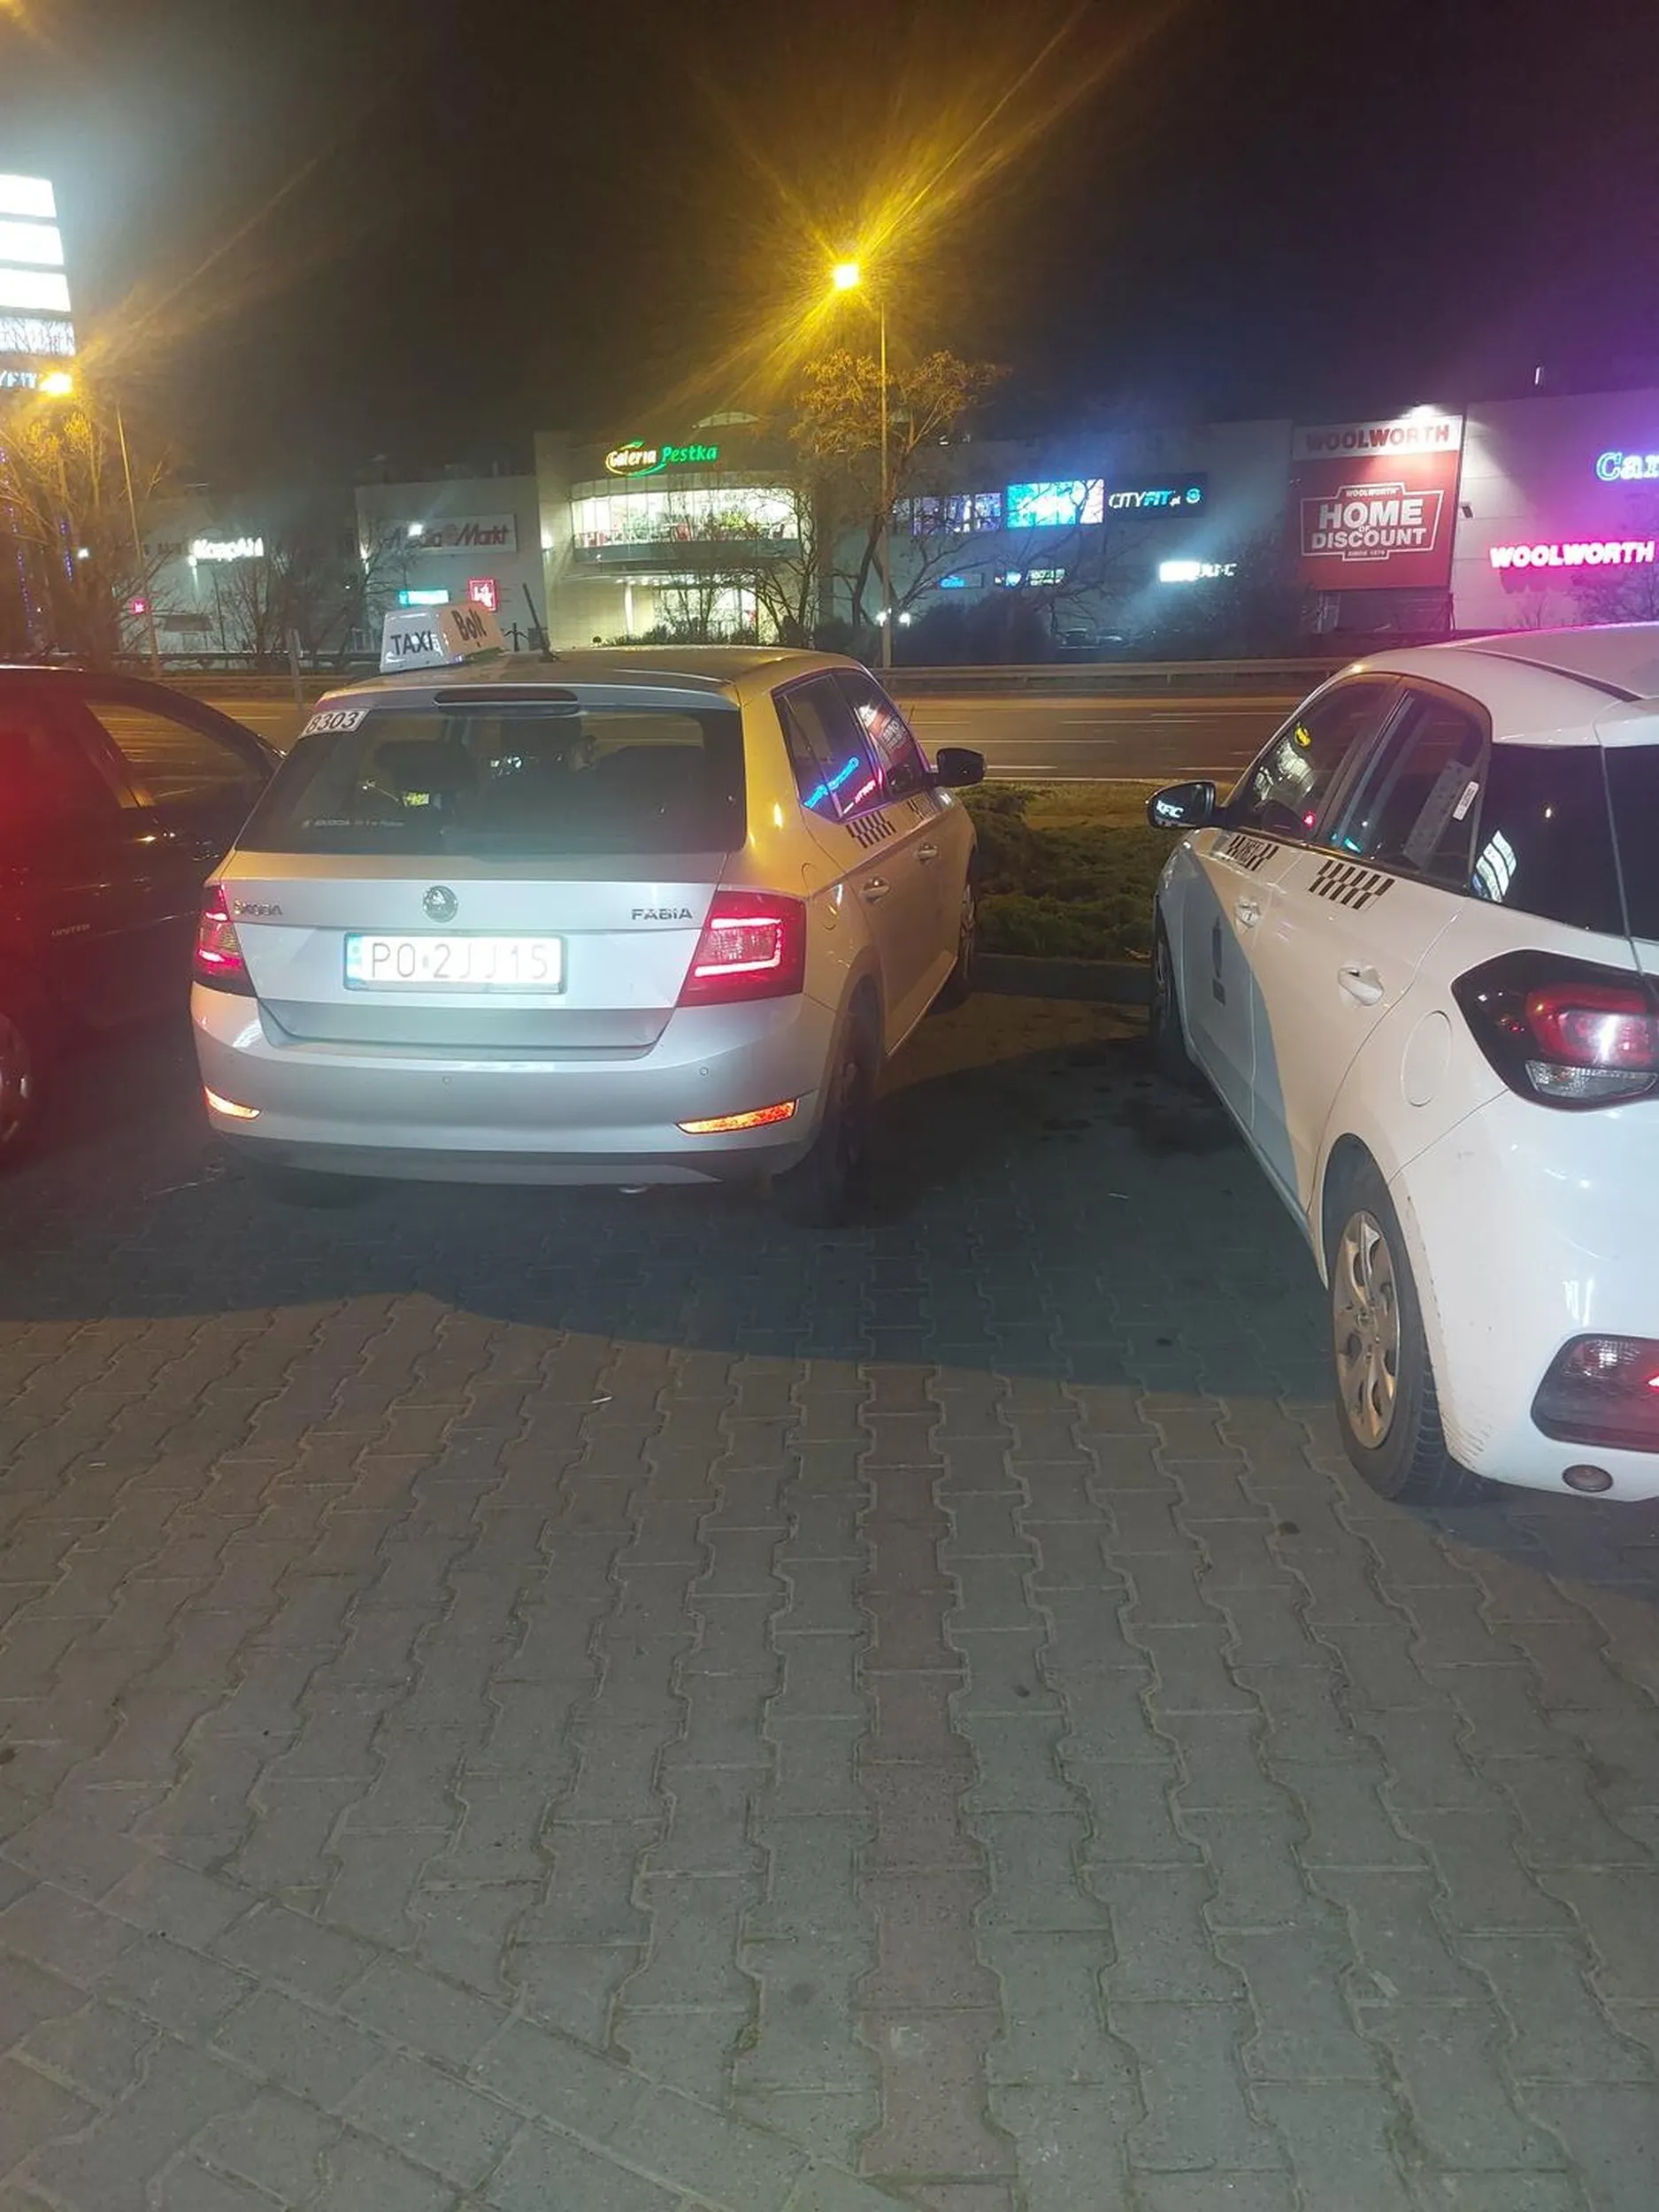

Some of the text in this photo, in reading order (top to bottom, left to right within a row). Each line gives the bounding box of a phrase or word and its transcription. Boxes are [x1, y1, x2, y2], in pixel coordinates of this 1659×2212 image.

[1307, 425, 1450, 452] WOOLWORTH
[662, 446, 718, 462] Pestka
[1319, 499, 1423, 531] HOME
[1311, 528, 1426, 549] DISCOUNT
[1490, 541, 1655, 568] WOOLWORTH
[390, 631, 434, 656] TAXI
[305, 711, 359, 734] 8303
[631, 908, 693, 920] FABIA
